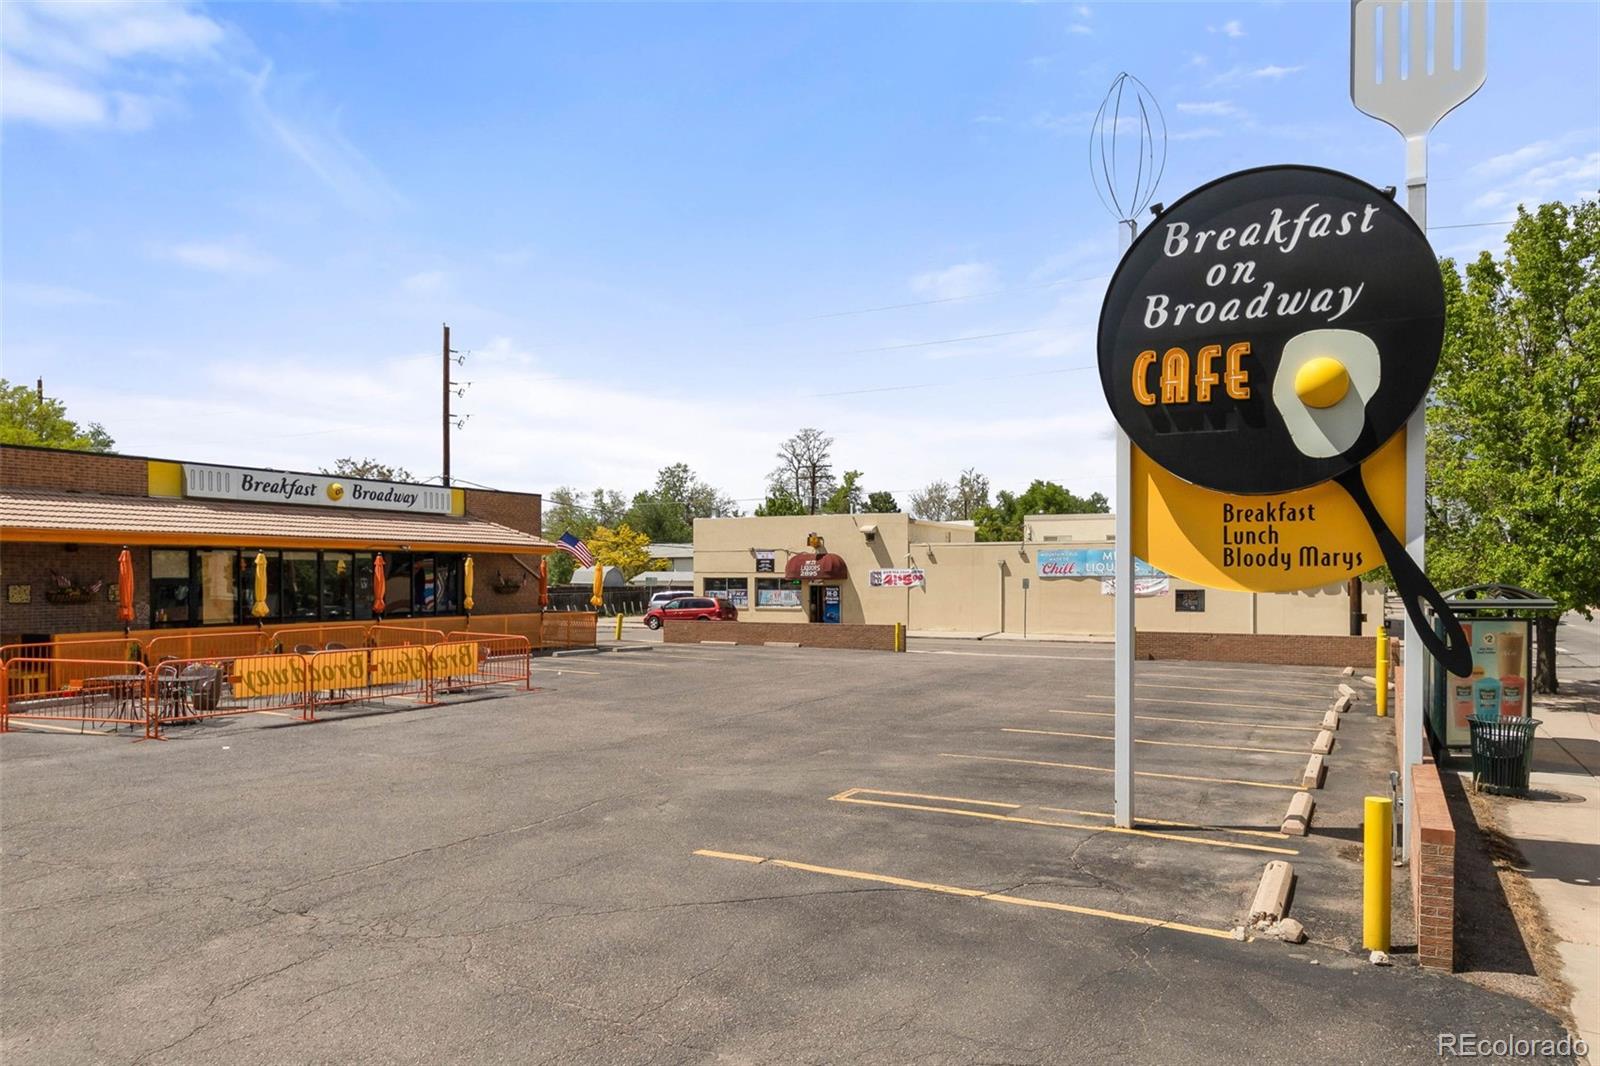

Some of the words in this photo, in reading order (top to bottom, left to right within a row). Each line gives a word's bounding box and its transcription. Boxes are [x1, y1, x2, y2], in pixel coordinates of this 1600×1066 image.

[1163, 202, 1379, 257] Breakfast
[1206, 260, 1255, 286] on
[1144, 282, 1364, 329] Broadway
[1132, 342, 1251, 406] CAFE
[241, 473, 317, 499] Breakfast
[352, 484, 418, 507] Broadway
[1223, 501, 1316, 523] Breakfast
[1223, 525, 1279, 546] Lunch
[1042, 562, 1075, 574] Chill
[1086, 562, 1140, 573] LIQUS
[1223, 546, 1291, 571] Bloody
[1299, 546, 1364, 571] Marys
